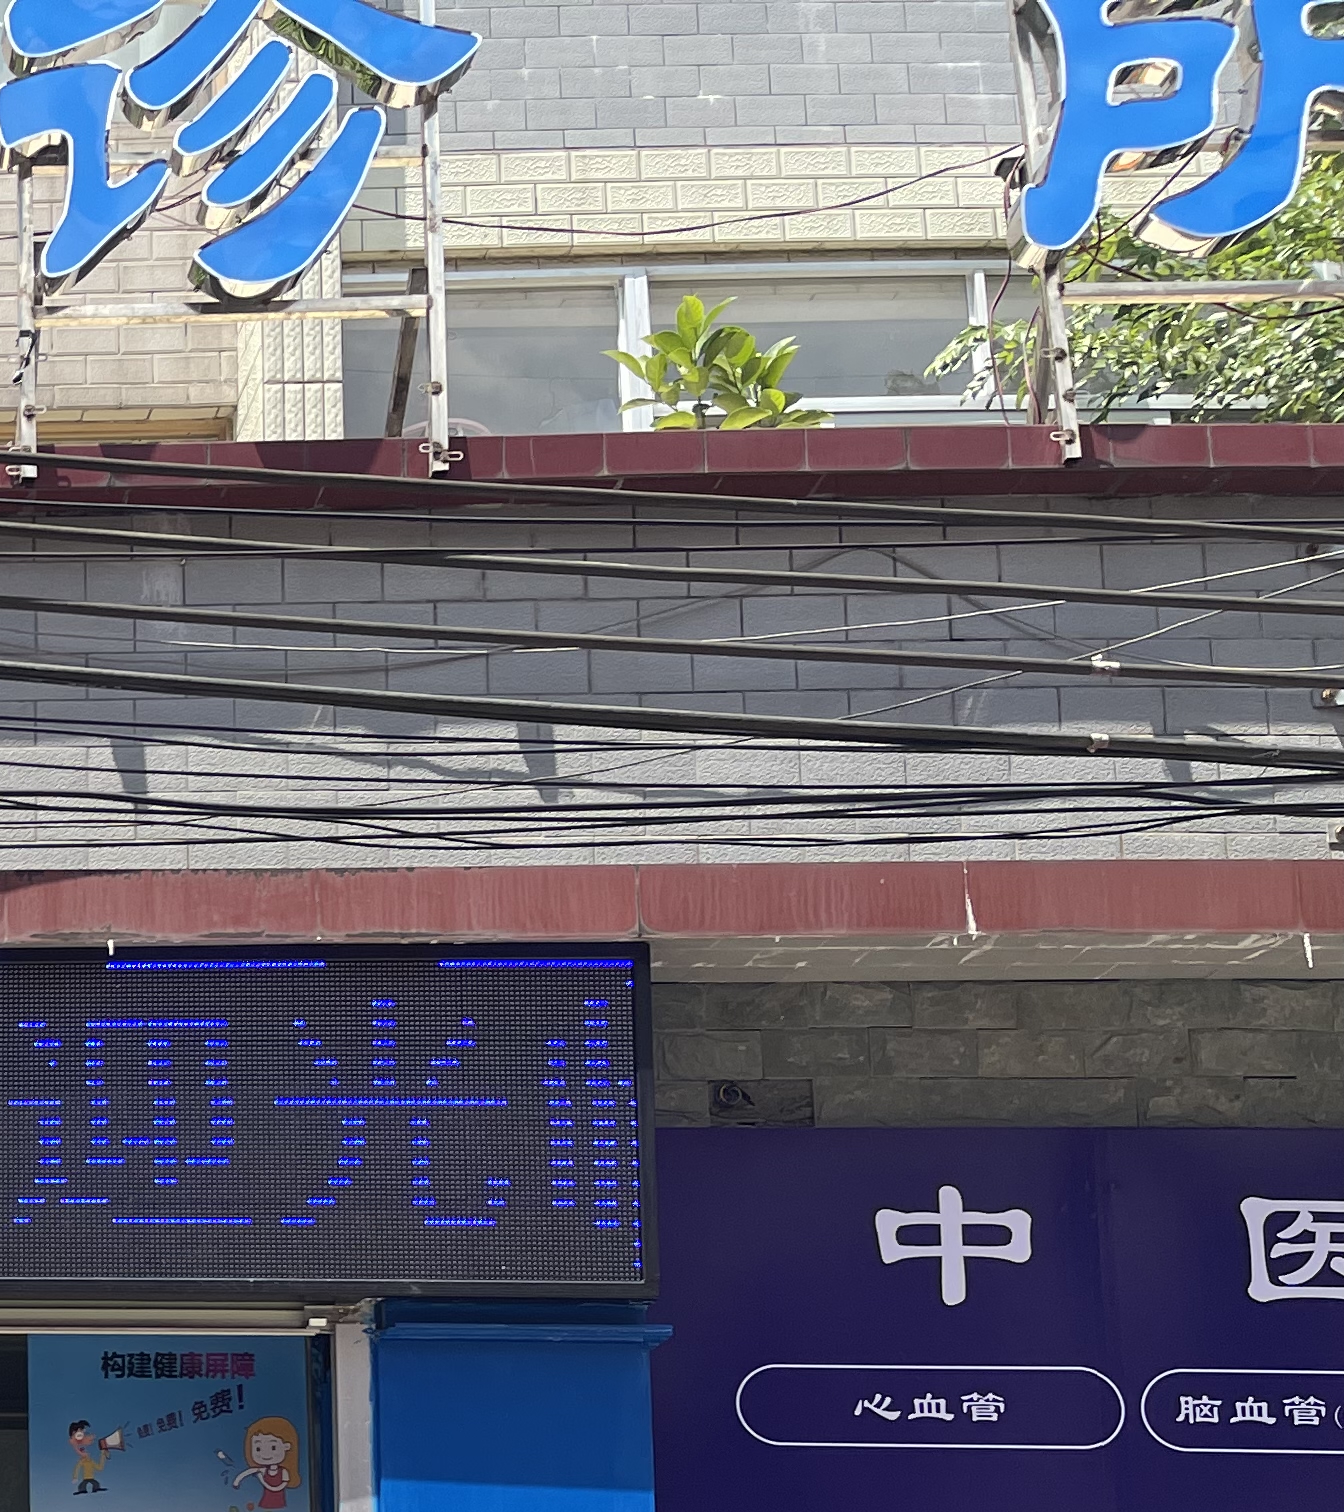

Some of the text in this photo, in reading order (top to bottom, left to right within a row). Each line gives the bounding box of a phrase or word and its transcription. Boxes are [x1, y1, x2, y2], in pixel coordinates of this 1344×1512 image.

[101, 1351, 257, 1380] 构建健康屏障
[853, 1391, 1006, 1423] 心血管
